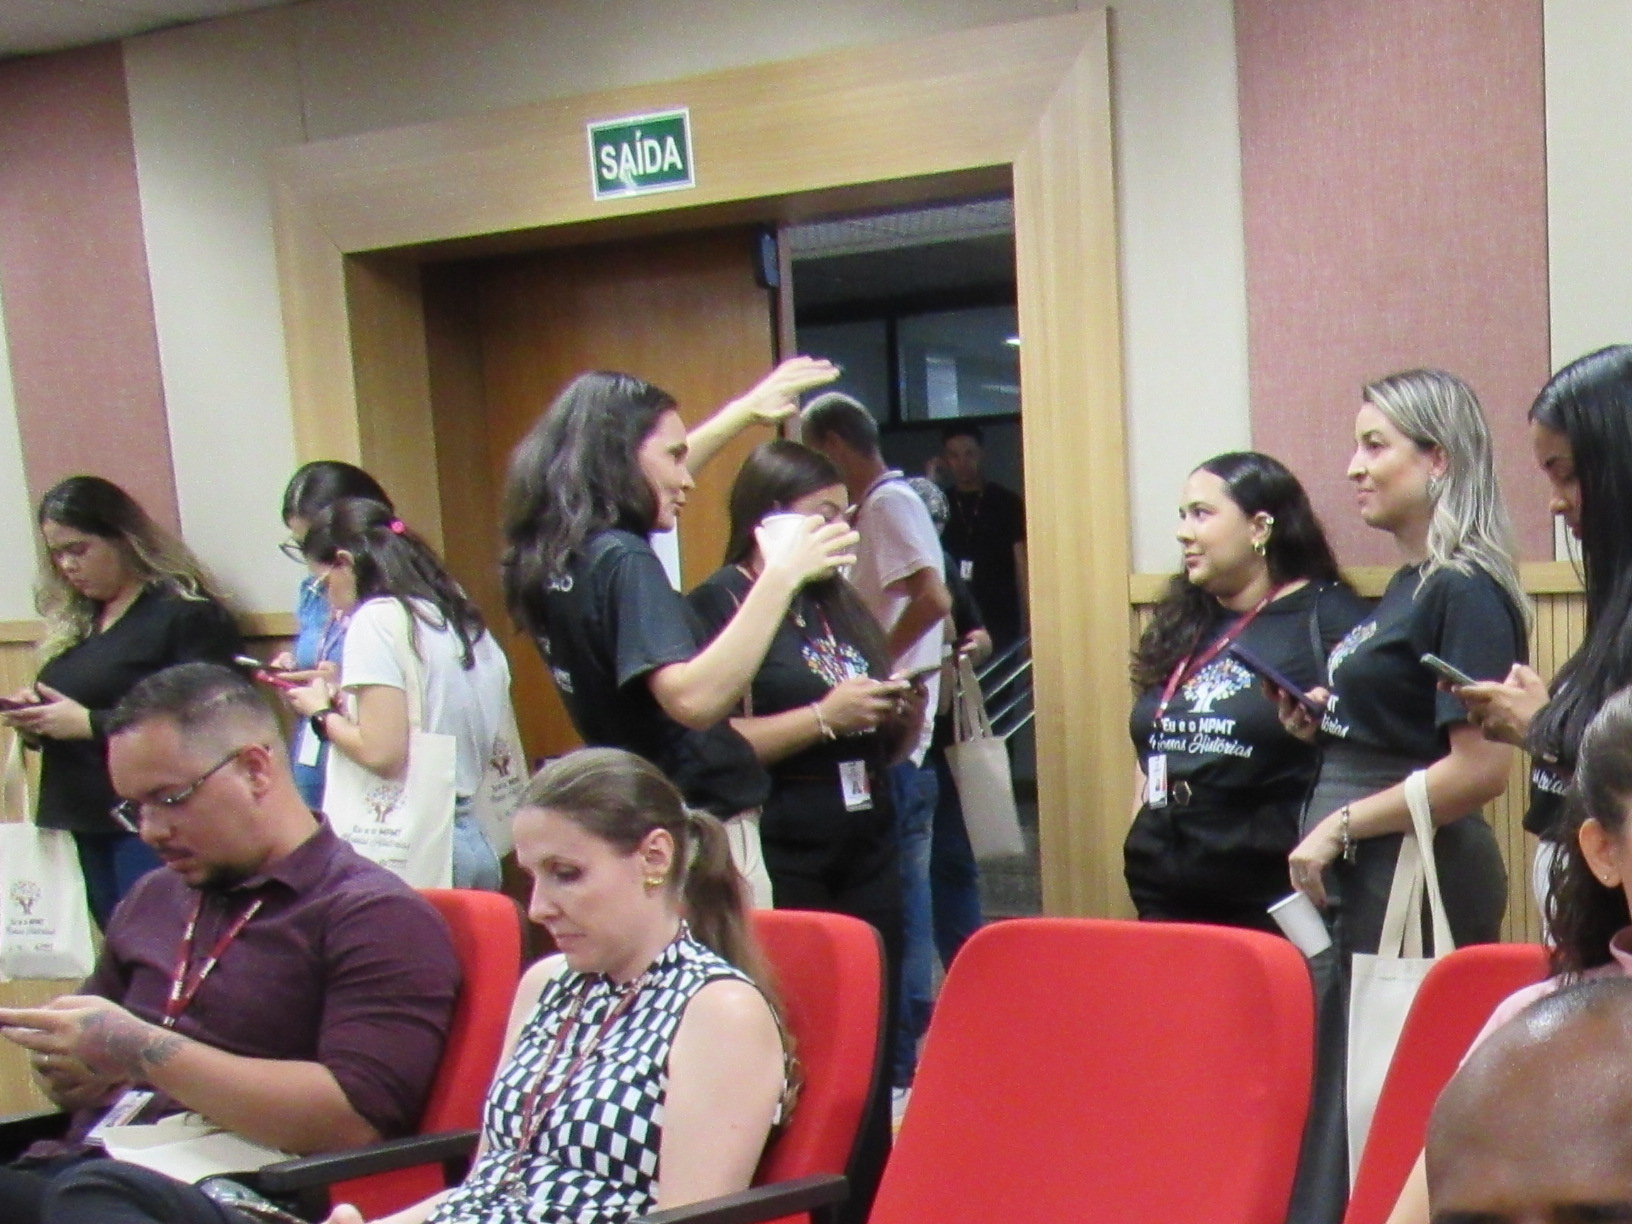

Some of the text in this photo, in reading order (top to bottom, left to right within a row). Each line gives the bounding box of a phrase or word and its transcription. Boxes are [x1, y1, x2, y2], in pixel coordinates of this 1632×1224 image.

[601, 129, 683, 180] SAÍDA
[1199, 717, 1236, 735] MPMT
[1188, 732, 1253, 759] Histórias
